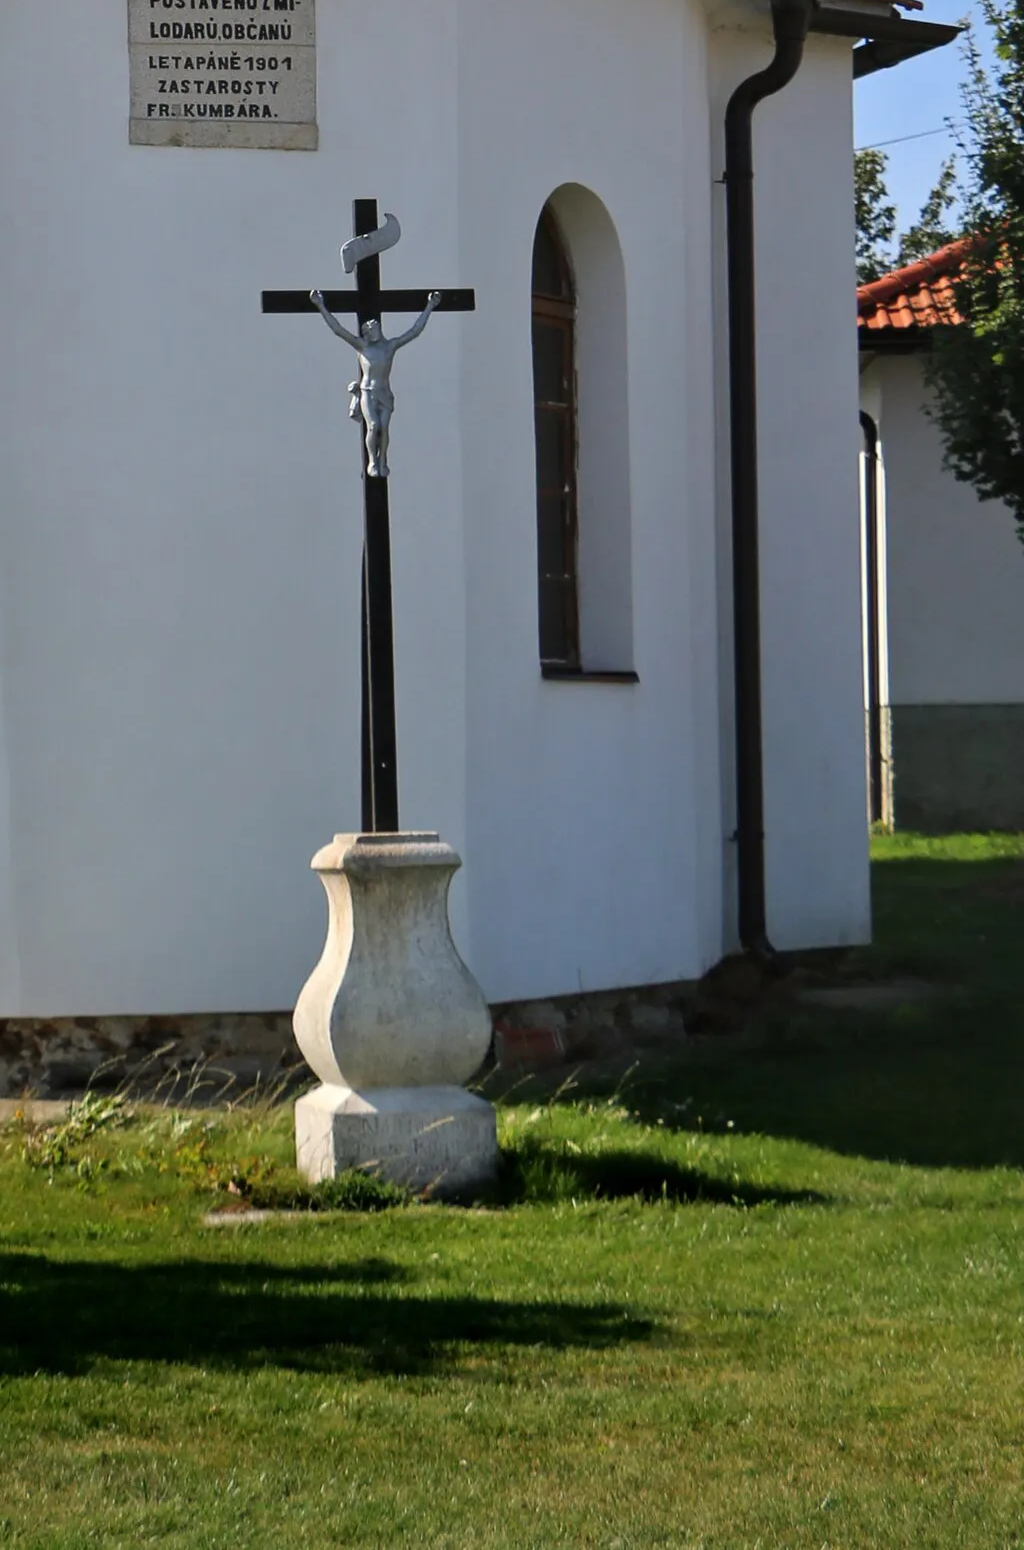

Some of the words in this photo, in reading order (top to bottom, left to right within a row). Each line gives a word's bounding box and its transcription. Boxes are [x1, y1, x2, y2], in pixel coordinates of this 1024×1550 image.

[244, 56, 292, 71] 1901
[147, 103, 176, 117] FR.
[183, 98, 278, 118] KUMBÁRA.
